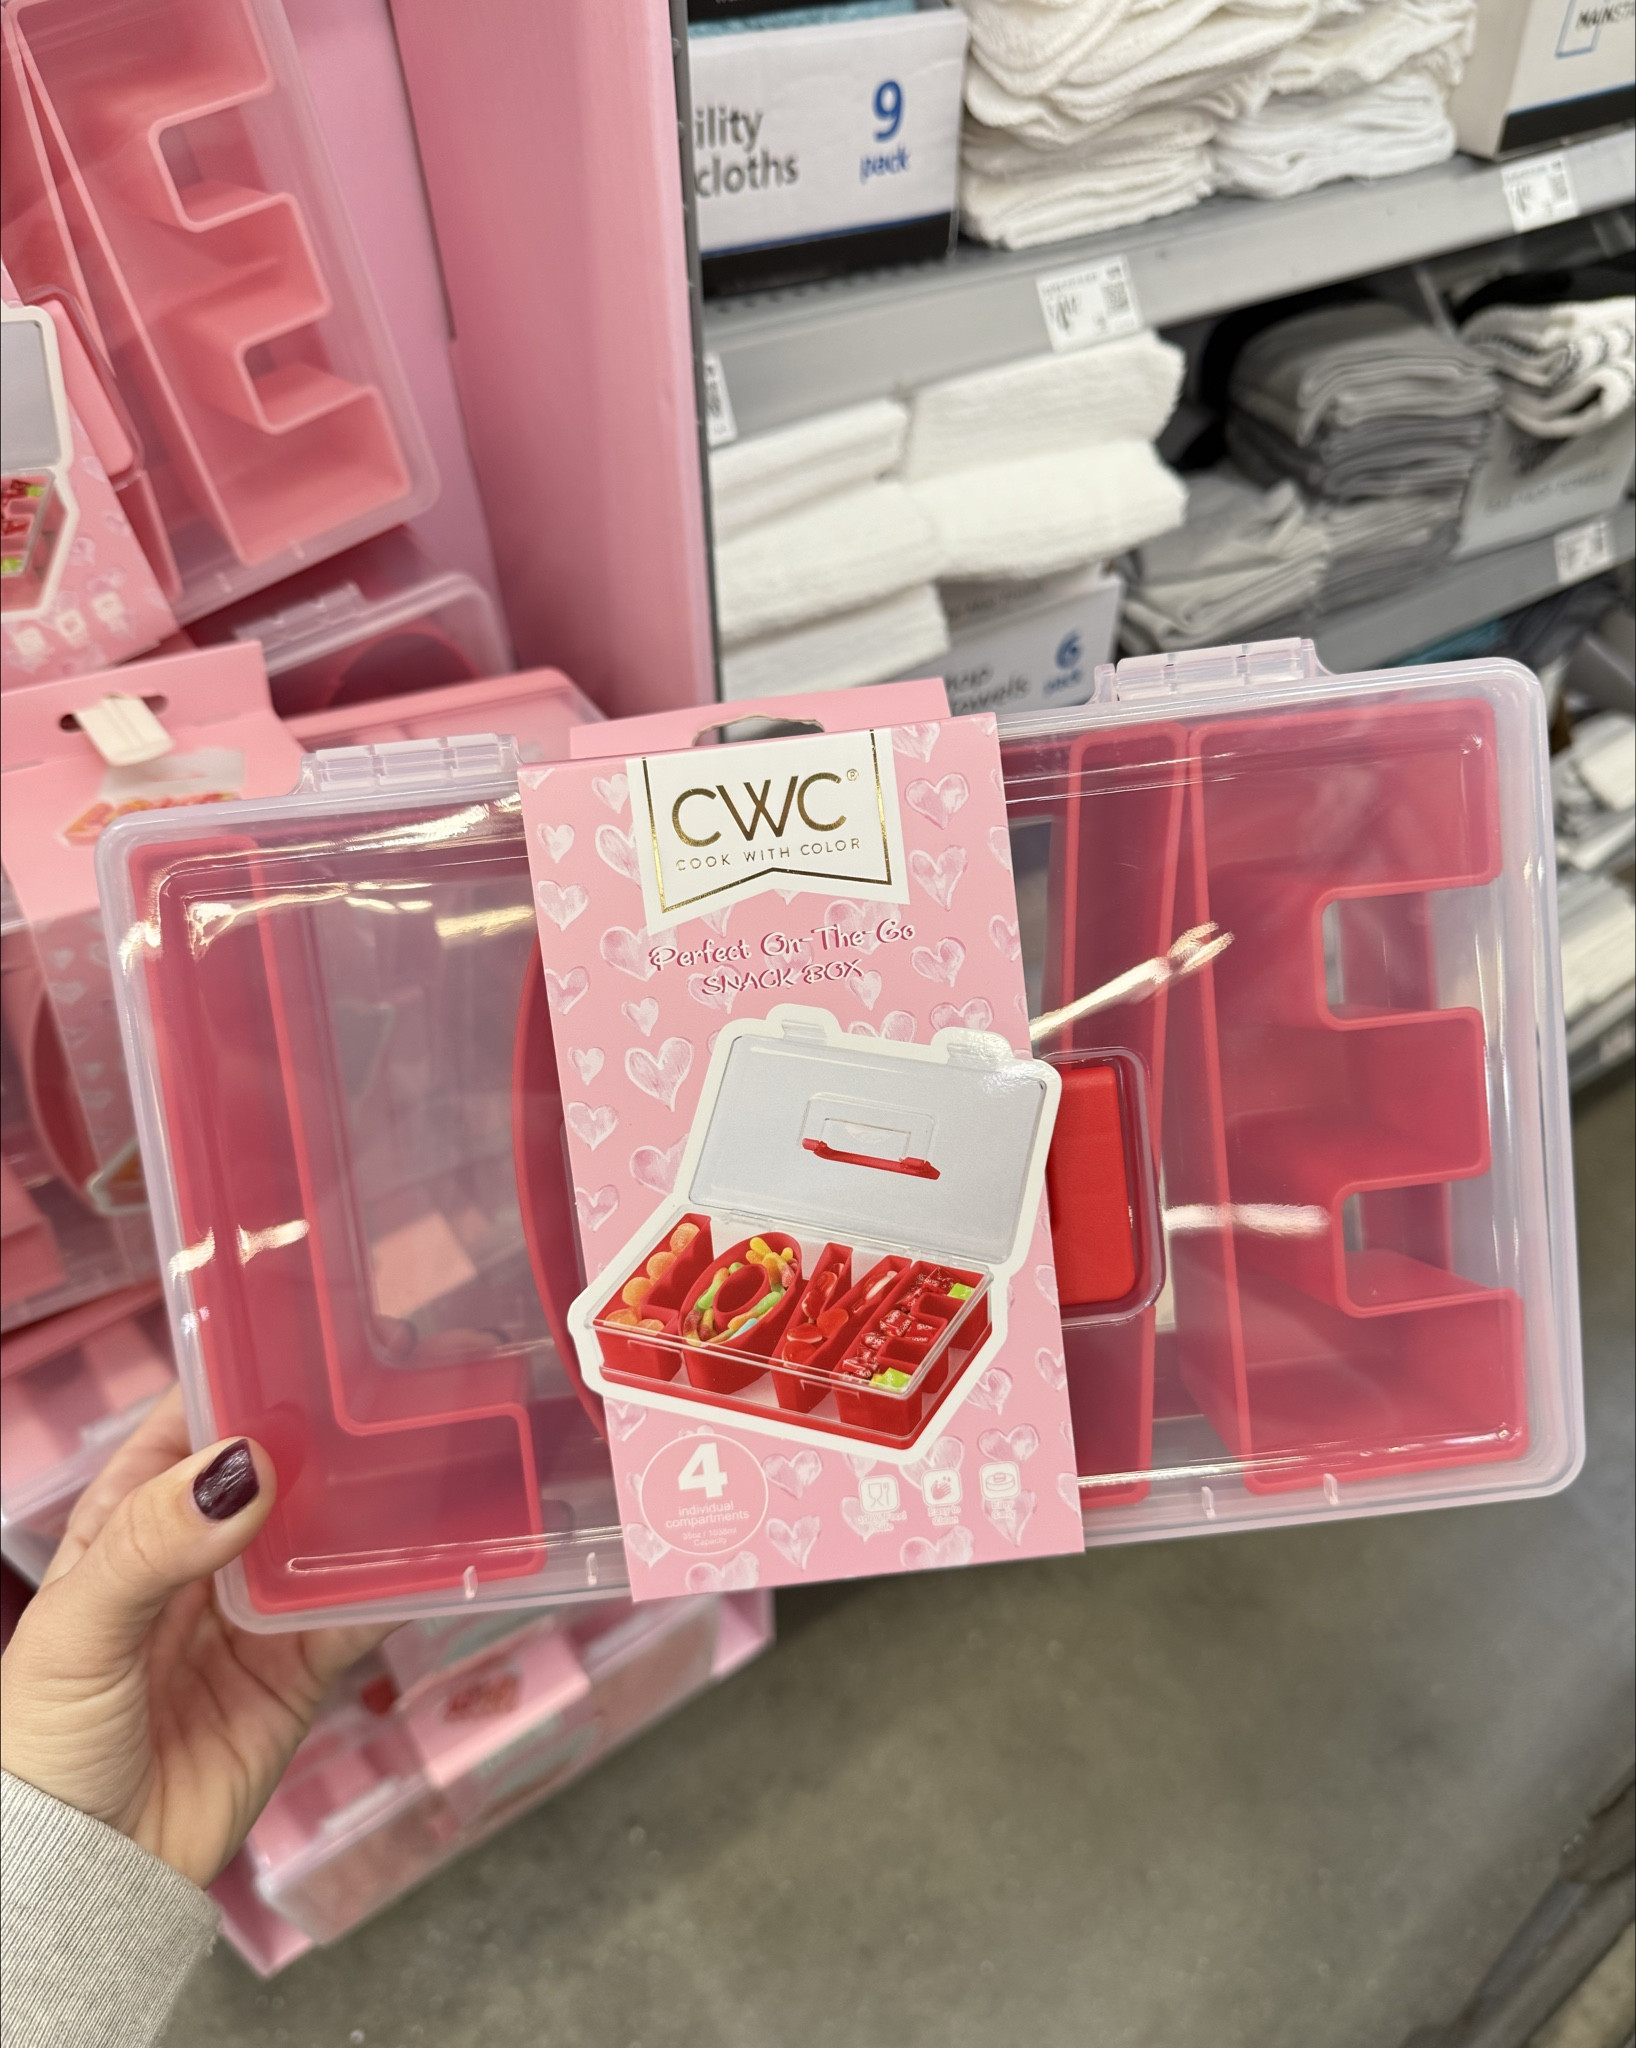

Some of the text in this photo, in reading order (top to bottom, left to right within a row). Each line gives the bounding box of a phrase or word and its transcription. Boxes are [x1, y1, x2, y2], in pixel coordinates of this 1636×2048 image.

[872, 79, 904, 142] 9
[860, 145, 910, 185] pack
[1055, 630, 1083, 669] 6
[675, 837, 860, 872] COOK WITH COLOR
[648, 938, 752, 973] Perfect
[701, 958, 866, 996] SNACK BOX
[678, 1442, 729, 1499] 4
[665, 1509, 750, 1529] compartments
[678, 1499, 734, 1517] individual
